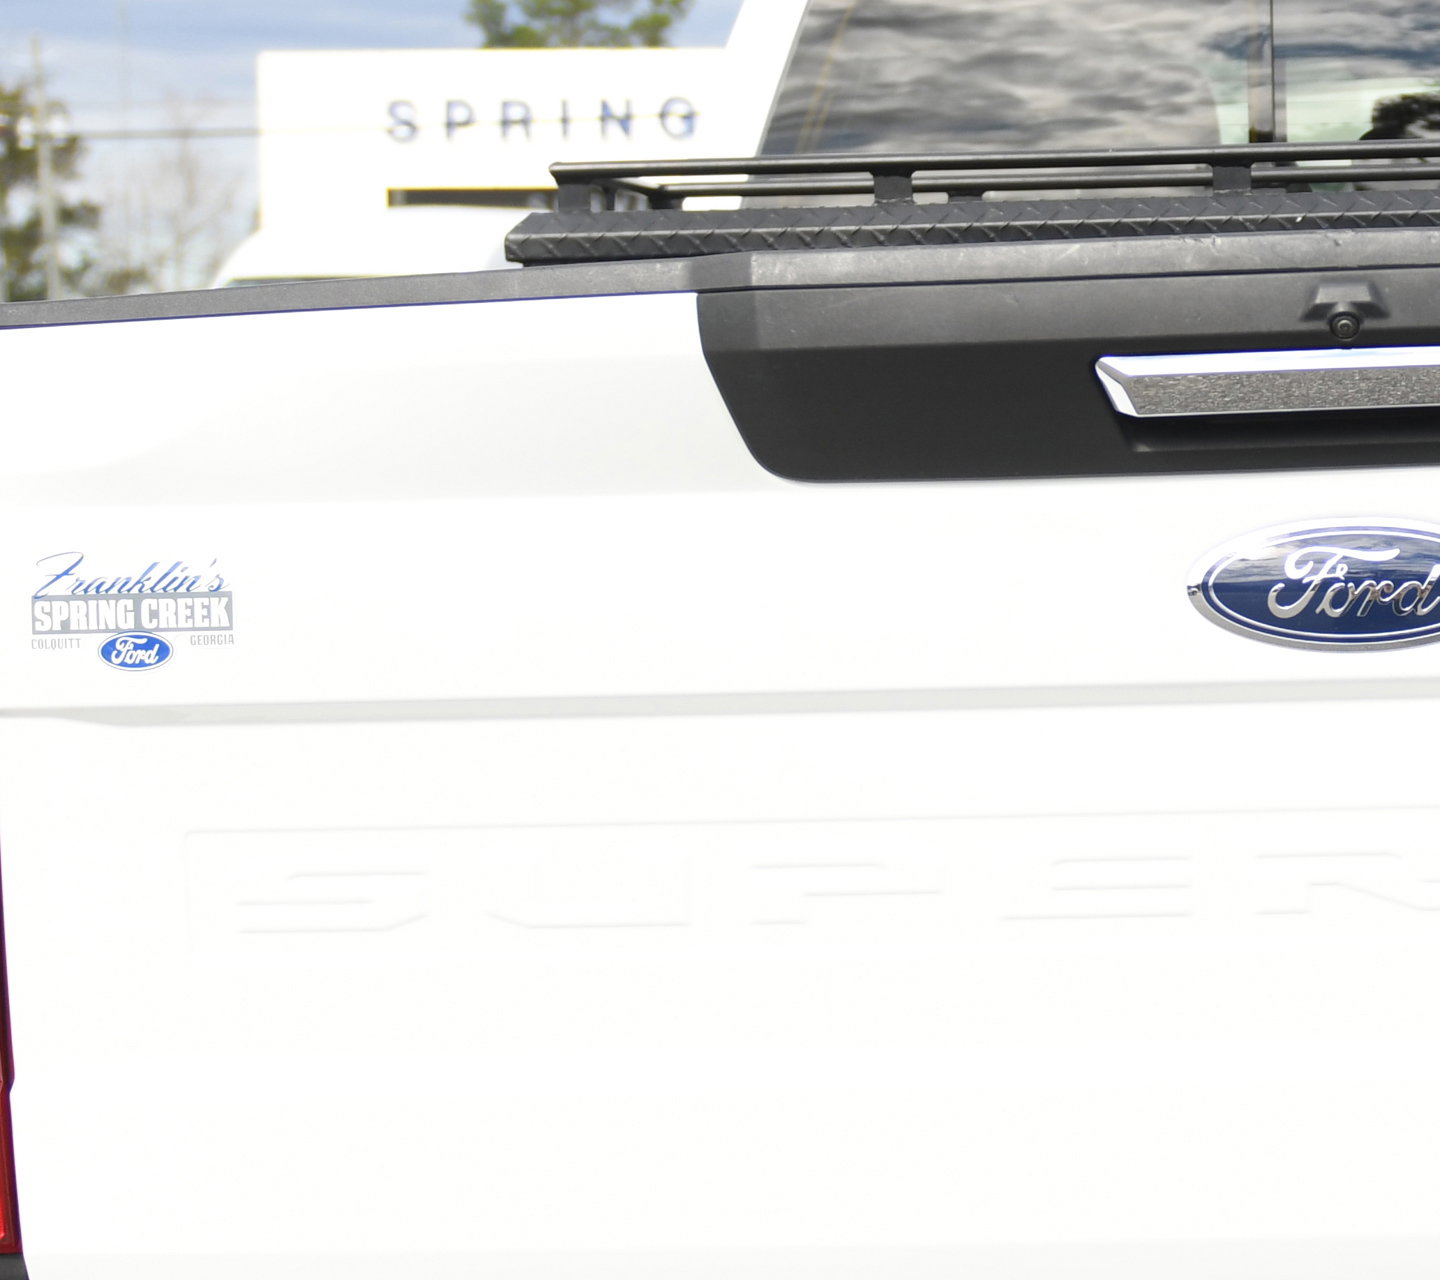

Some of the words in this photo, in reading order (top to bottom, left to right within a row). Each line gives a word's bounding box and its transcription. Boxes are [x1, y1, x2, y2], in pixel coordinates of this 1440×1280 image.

[386, 97, 698, 143] SPRING
[33, 552, 232, 599] Franklin's
[34, 598, 135, 632] SPRING
[141, 596, 231, 631] CREEK
[31, 637, 82, 650] COLQUITT
[111, 636, 160, 665] Ford
[190, 634, 234, 646] GEORGIA
